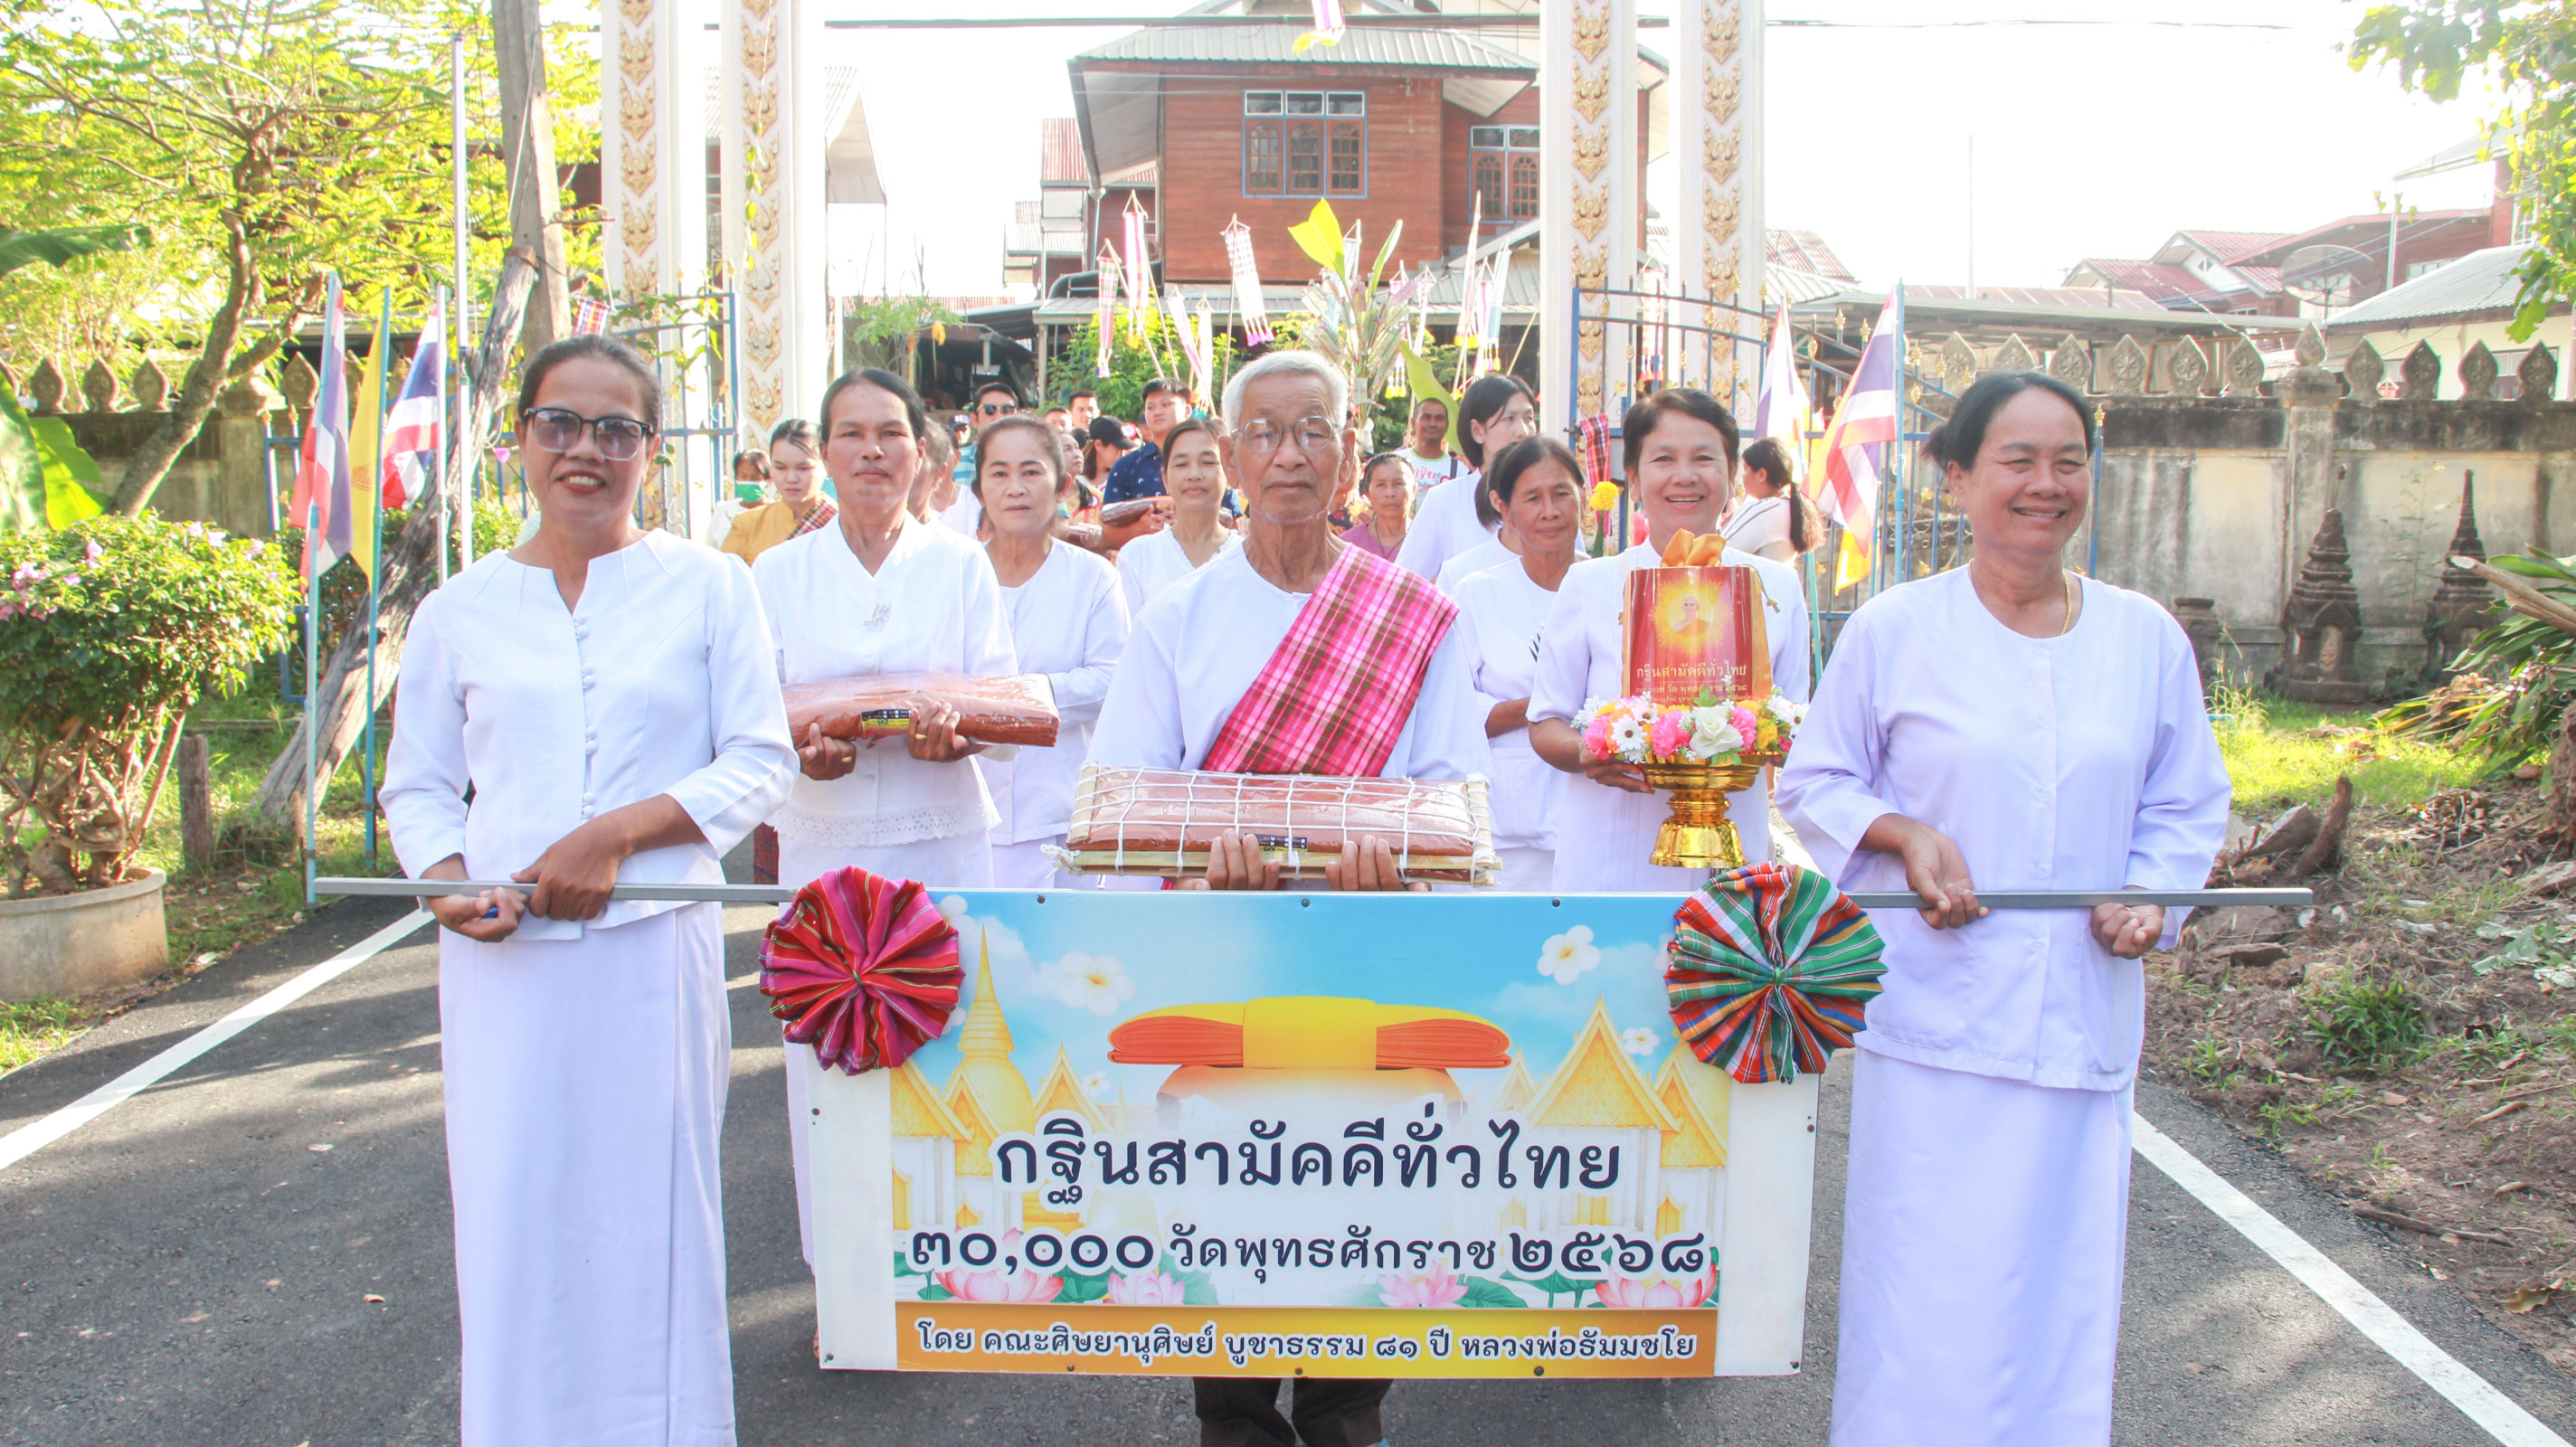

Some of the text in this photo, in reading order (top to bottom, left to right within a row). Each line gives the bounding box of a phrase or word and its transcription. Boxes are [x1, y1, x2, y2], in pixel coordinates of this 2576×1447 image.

[1636, 658, 1747, 681] กฐินสามัคคีทั่วไทย
[997, 1101, 1621, 1205] กฐินสามัคคีทั่วไทย
[913, 1223, 1705, 1285] ๓๐,๐๐๐ วัดพุทธศักราช ๒๕๖๘
[918, 1321, 1694, 1366] โดย คณะศิษยานุศิษย์ บูชาธรรม ๘๑ ปี หลวงพ่อธัมมชโย
